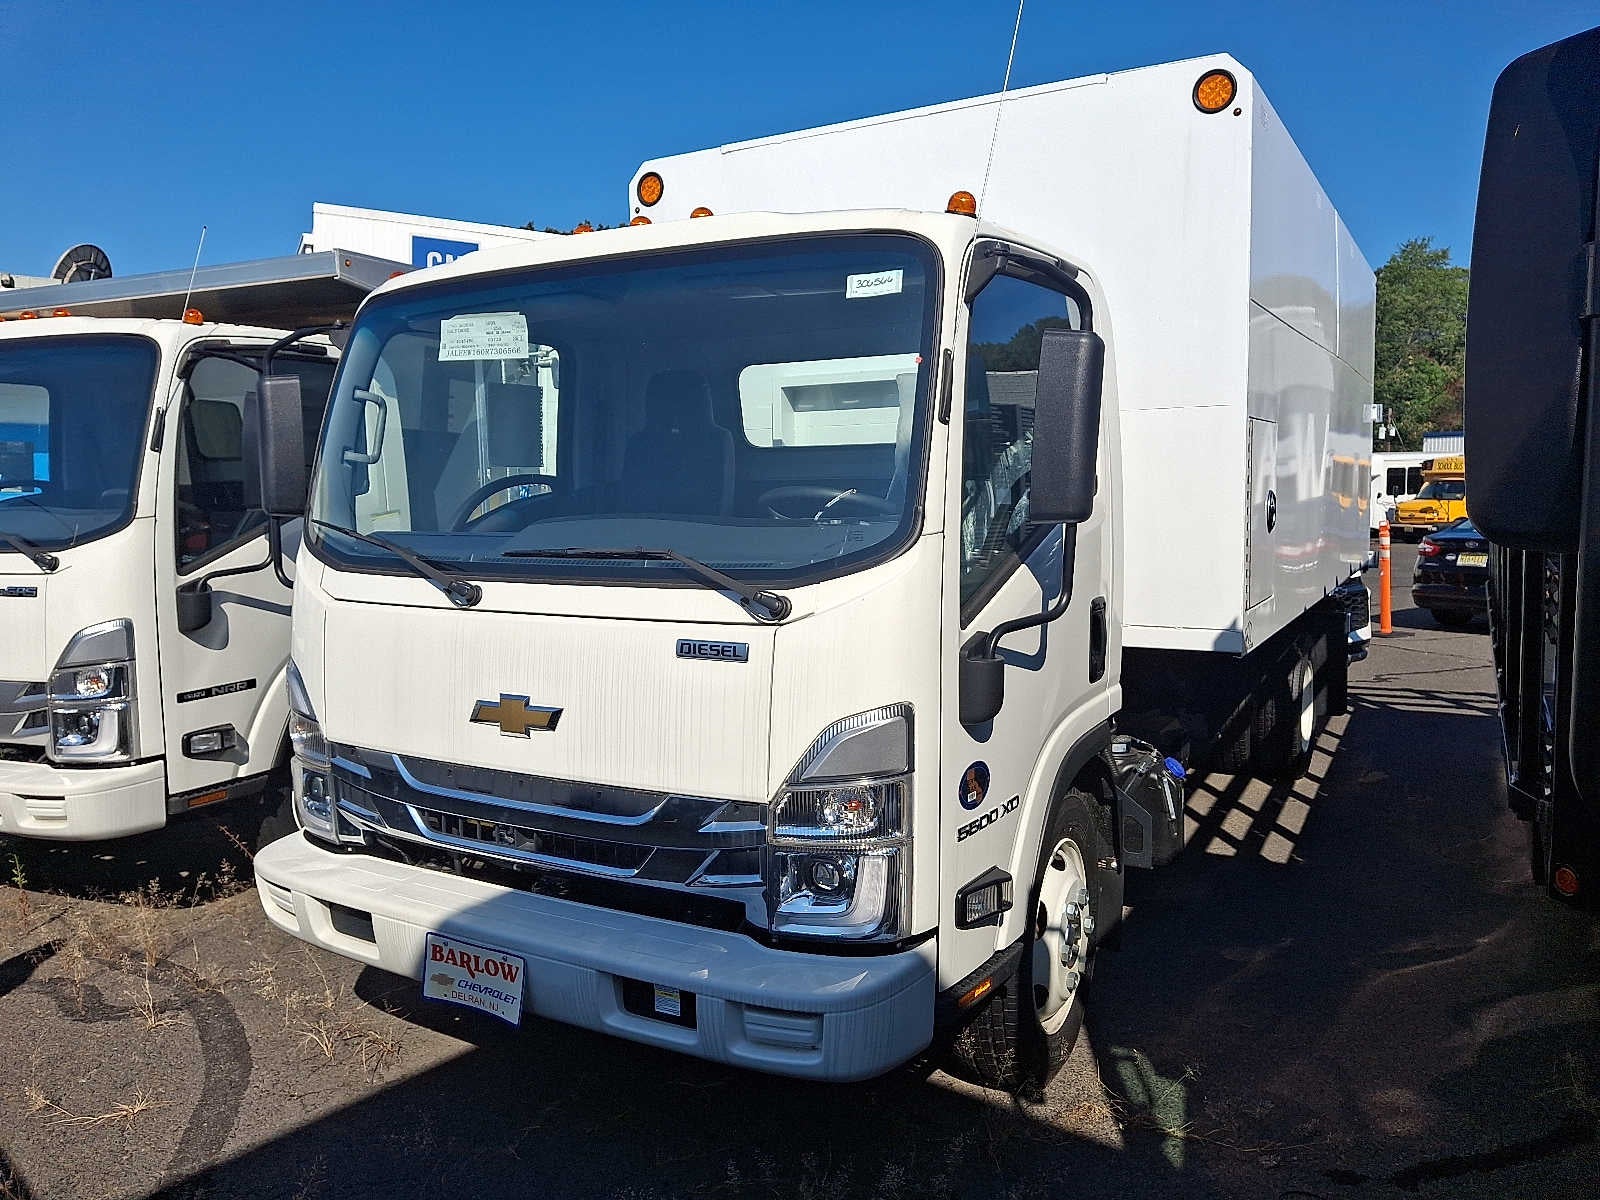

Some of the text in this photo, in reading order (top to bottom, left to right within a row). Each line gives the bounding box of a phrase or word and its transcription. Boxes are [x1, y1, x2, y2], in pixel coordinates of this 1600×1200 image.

[1437, 462, 1453, 470] SCHOOL
[679, 642, 743, 658] DIESEL
[211, 681, 248, 696] NRR
[1000, 795, 1020, 819] XD
[430, 943, 520, 984] BARLOW
[457, 979, 518, 1005] CHEVROLET
